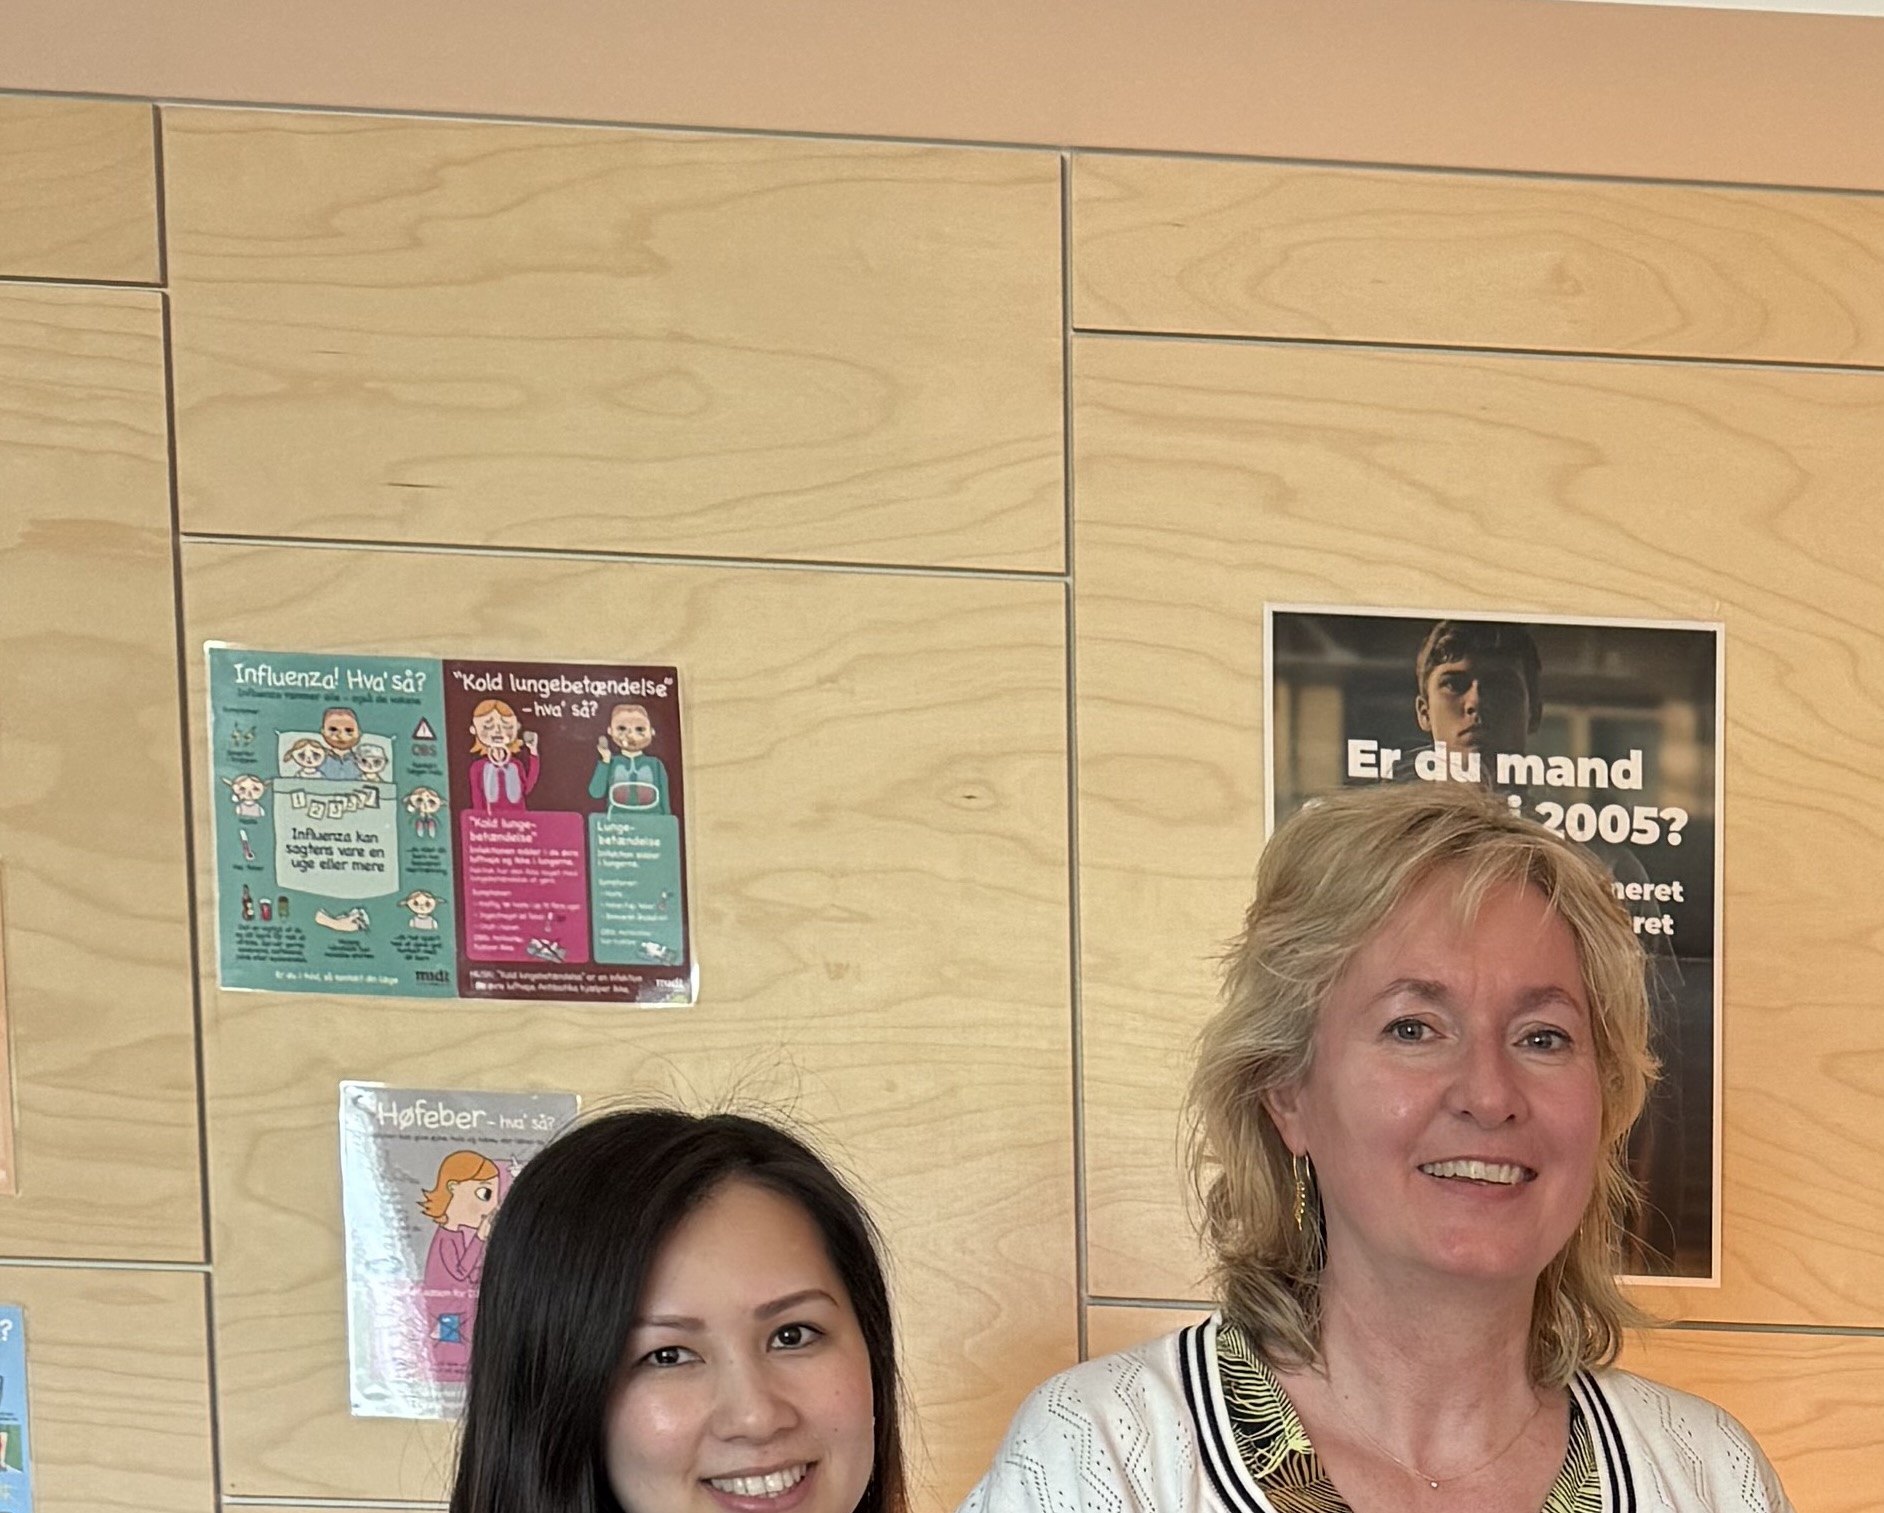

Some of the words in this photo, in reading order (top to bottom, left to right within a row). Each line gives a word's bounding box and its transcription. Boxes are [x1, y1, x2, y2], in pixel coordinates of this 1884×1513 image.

[234, 663, 339, 690] Influenza!
[347, 669, 387, 692] Hva'
[392, 669, 426, 693] så?
[571, 700, 598, 718] så?
[1347, 739, 1401, 780] Er
[1414, 741, 1481, 784] du
[1496, 749, 1643, 790] mand
[1535, 801, 1688, 846] 2005?
[292, 827, 351, 843] Influenza
[356, 830, 378, 844] kan
[286, 843, 333, 858] sagtens
[370, 848, 385, 859] en
[291, 859, 314, 873] uge
[320, 858, 347, 871] eller
[352, 860, 385, 872] mere
[1611, 881, 1684, 902] neret
[1633, 914, 1674, 935] ret
[376, 1099, 487, 1130] Høfeber
